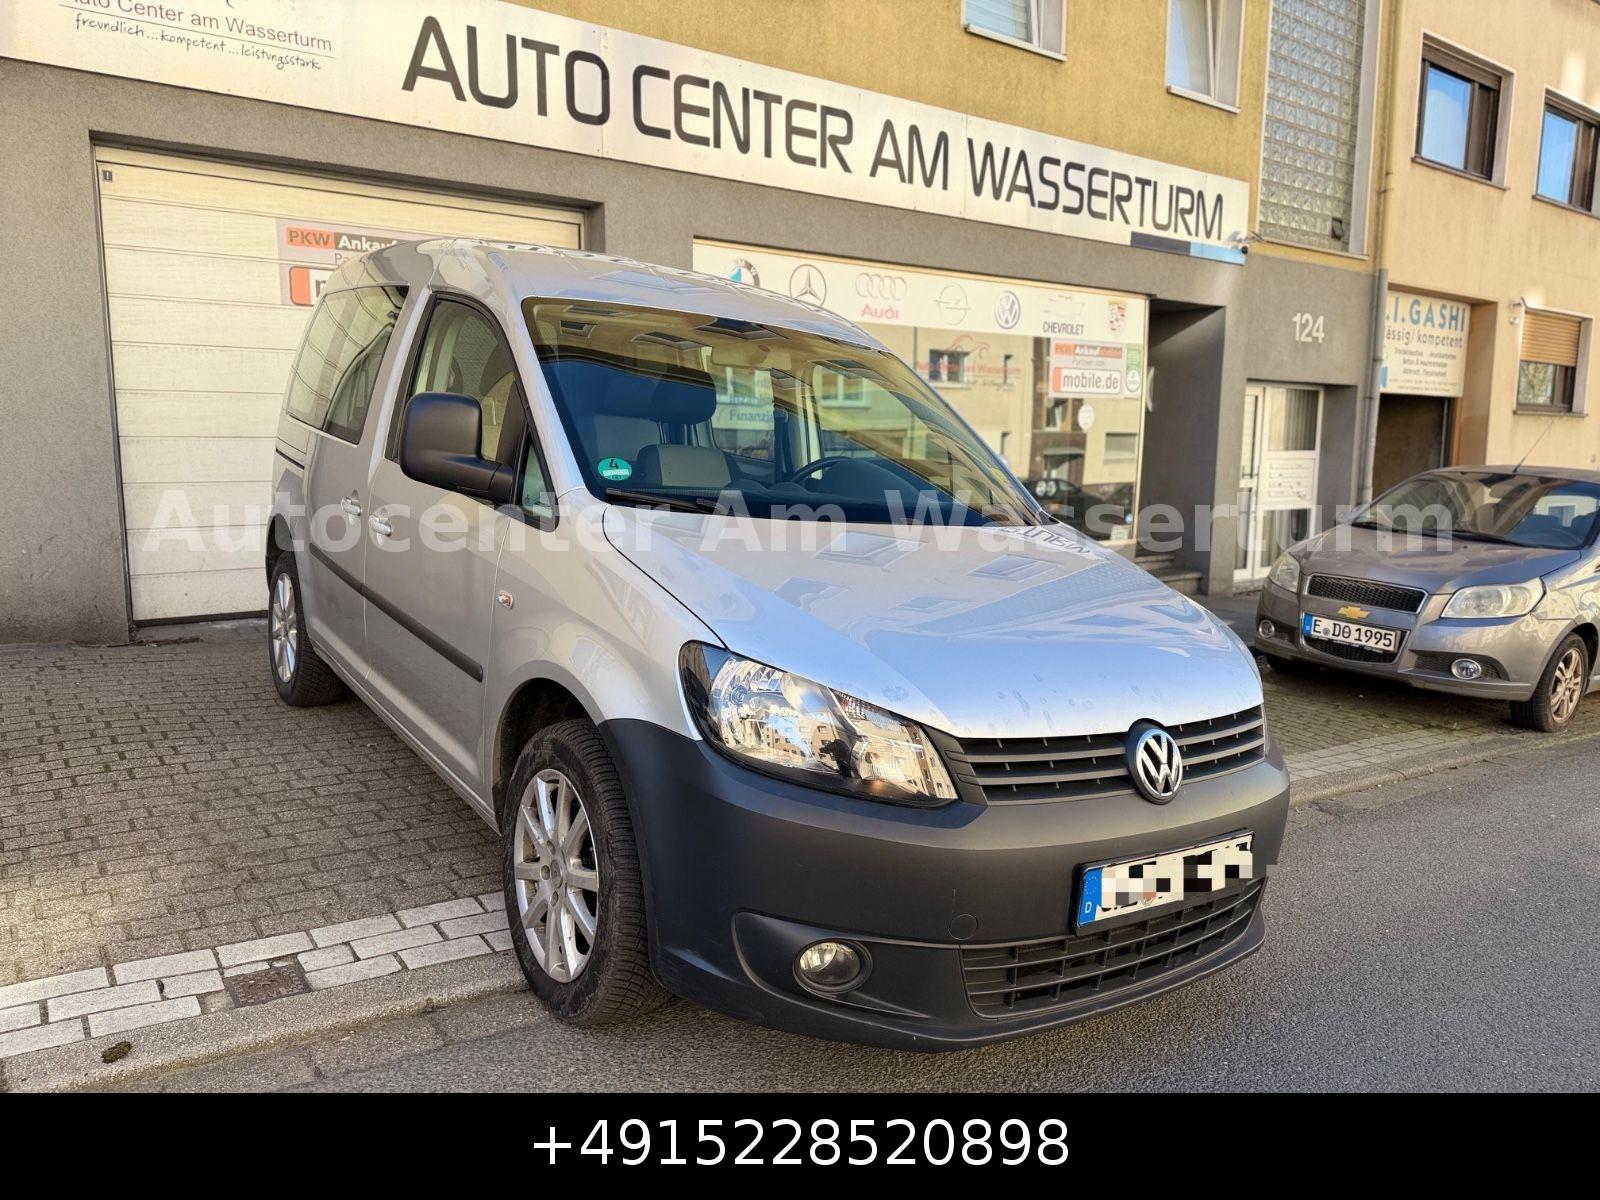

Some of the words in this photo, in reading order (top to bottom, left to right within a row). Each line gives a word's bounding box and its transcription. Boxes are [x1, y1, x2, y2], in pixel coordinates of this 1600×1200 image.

[118, 0, 184, 22] Center
[190, 13, 219, 29] am
[225, 16, 332, 51] Wasserturm
[401, 15, 610, 126] AUTO
[632, 64, 854, 173] CENTER
[869, 118, 949, 191] AM
[967, 137, 1223, 241] WASSERTURM
[289, 229, 331, 247] PKW
[860, 303, 899, 321] Audi
[1042, 321, 1085, 336] CHEVROLET
[1292, 312, 1325, 344] 124
[1062, 371, 1119, 390] mobile.de
[609, 458, 619, 470] 4
[1313, 618, 1322, 633] E
[1354, 627, 1393, 648] 1995
